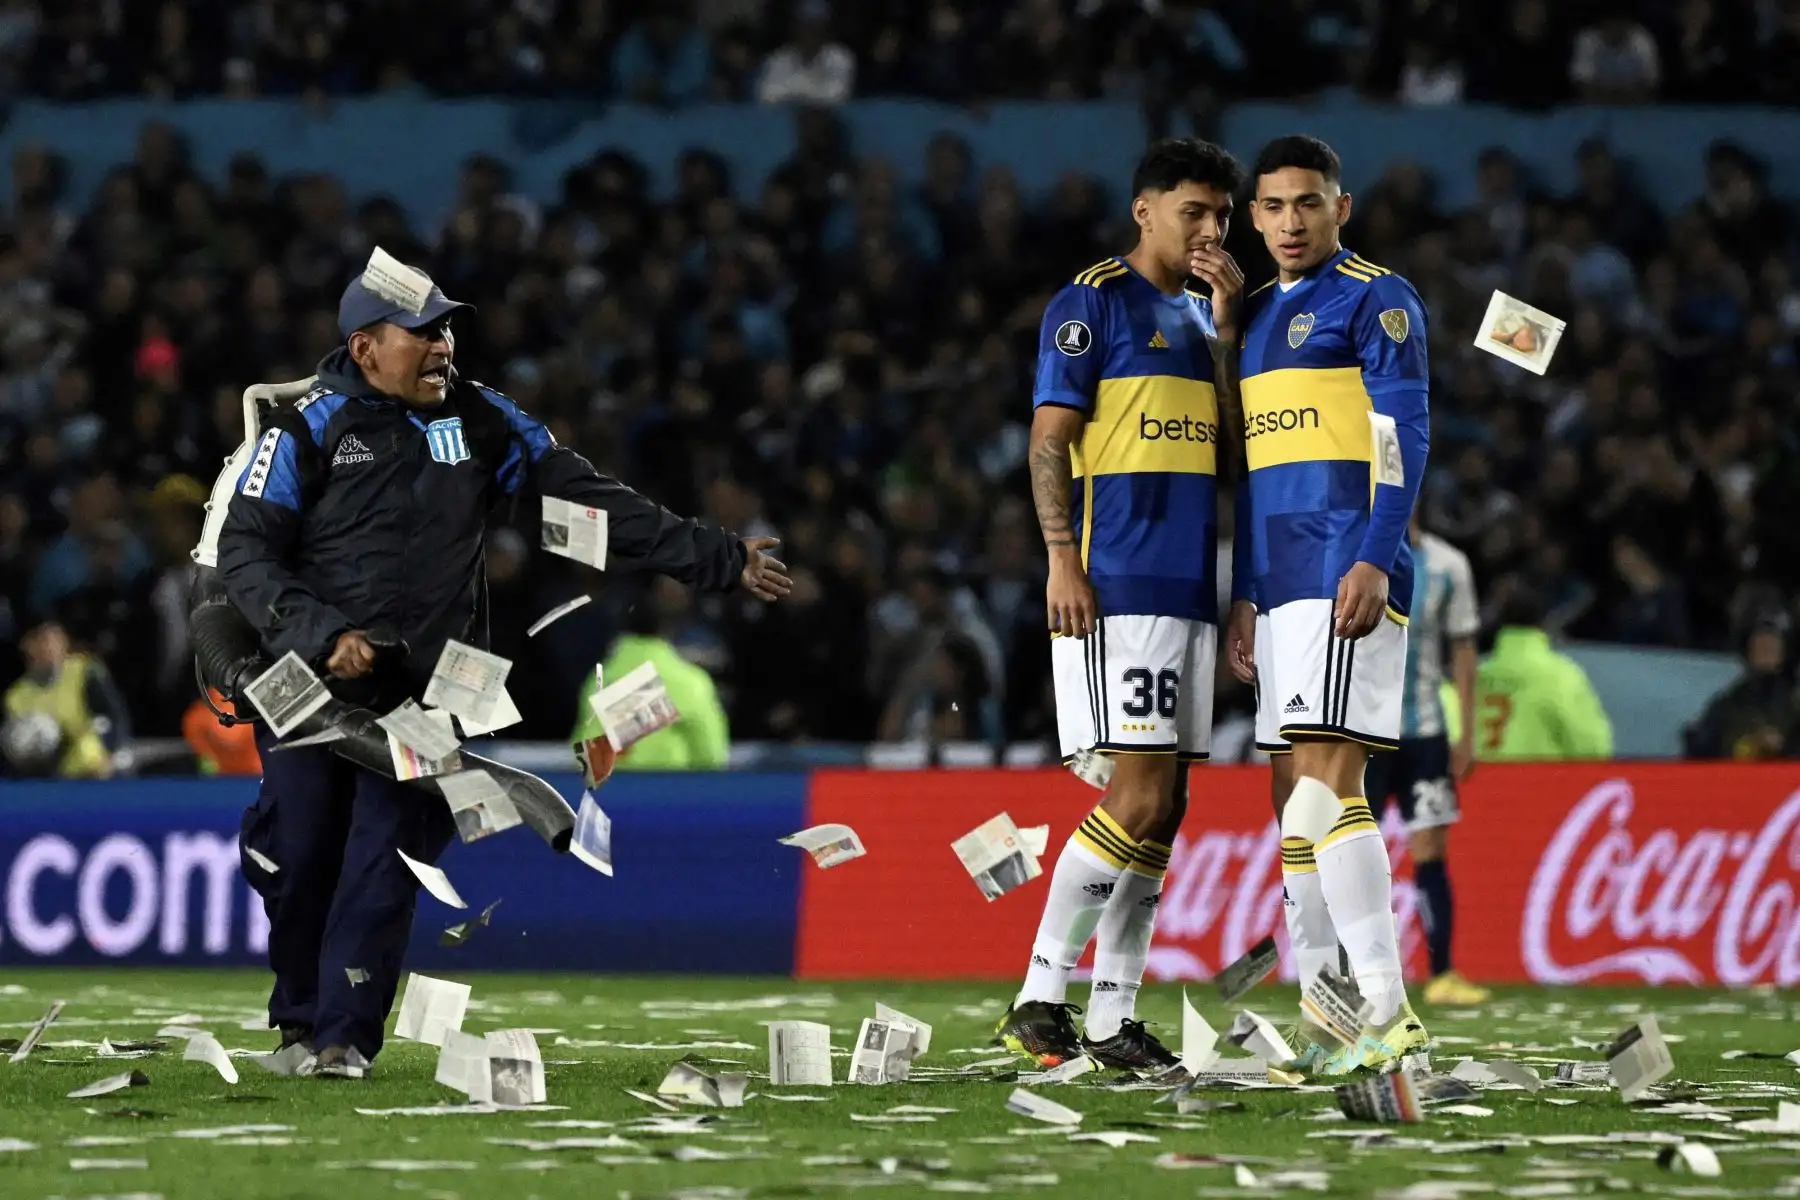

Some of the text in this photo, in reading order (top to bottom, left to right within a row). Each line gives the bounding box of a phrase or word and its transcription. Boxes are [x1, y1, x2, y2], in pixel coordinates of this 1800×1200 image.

[1120, 666, 1179, 719] 36
[1283, 705, 1310, 714] adidas
[0, 830, 269, 957] com
